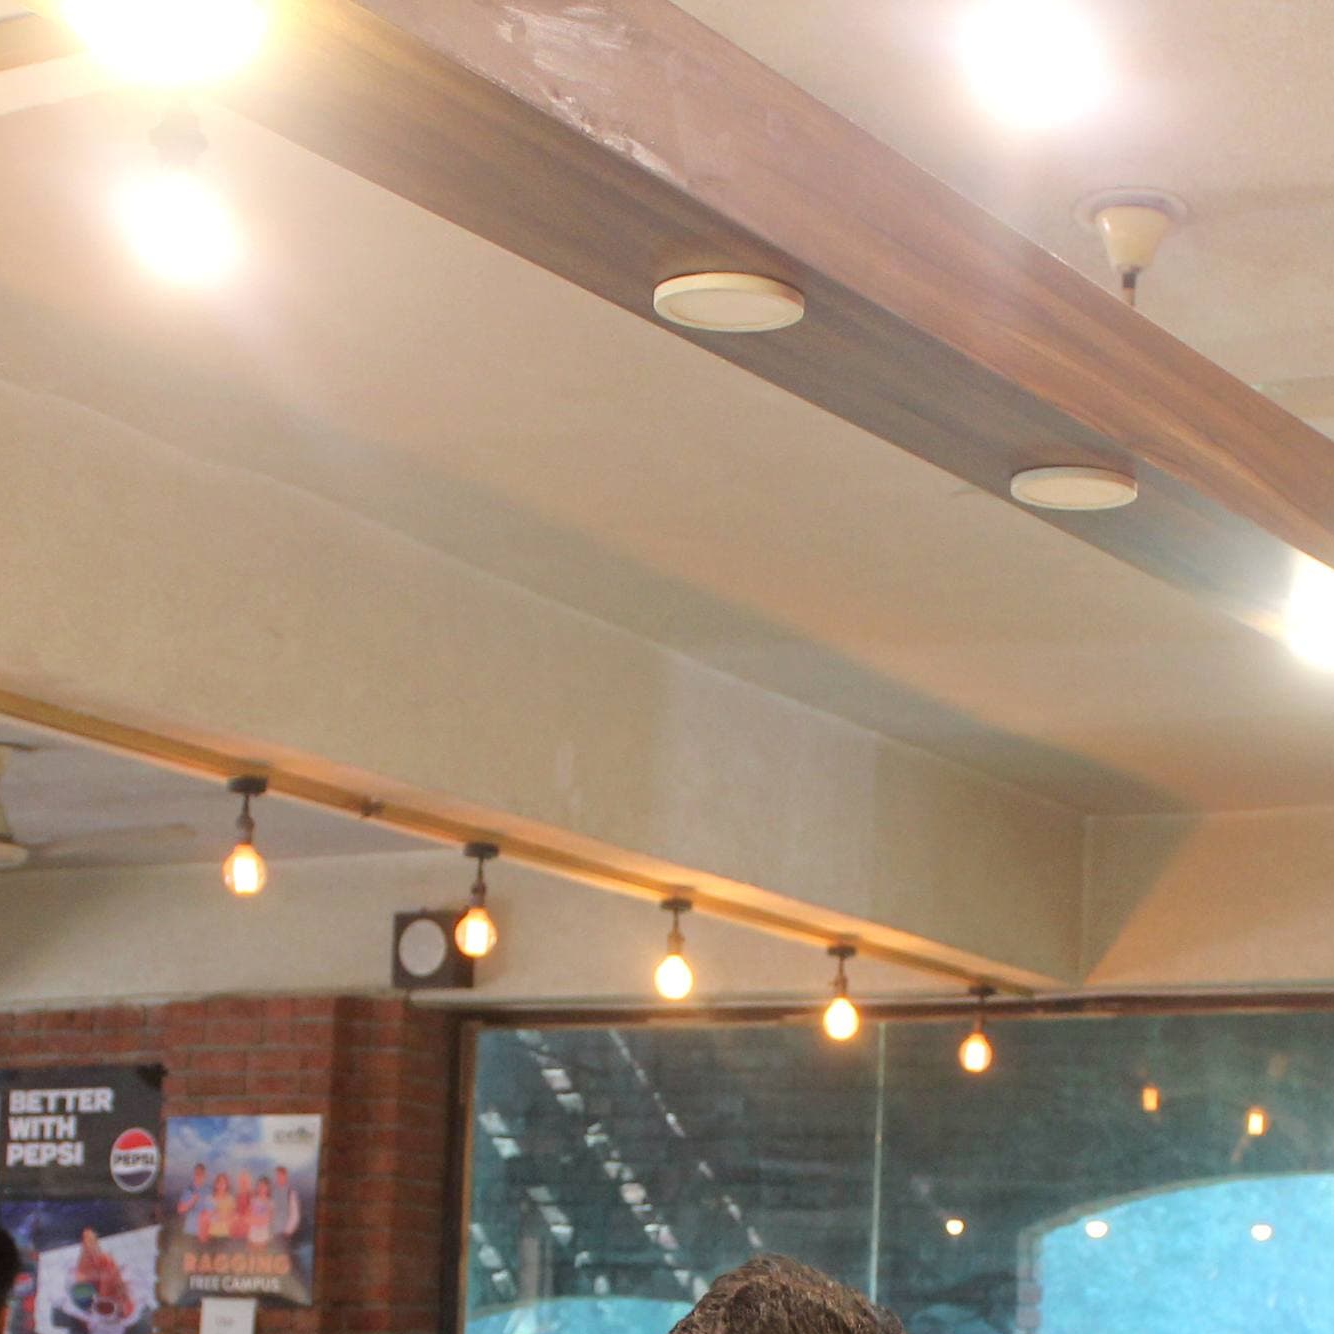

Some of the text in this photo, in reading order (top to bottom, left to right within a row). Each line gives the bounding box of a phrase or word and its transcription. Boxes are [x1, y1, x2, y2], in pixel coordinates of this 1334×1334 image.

[9, 1087, 114, 1113] BETTER
[9, 1115, 77, 1140] WITH
[6, 1142, 85, 1167] PEPSI
[113, 1152, 156, 1167] PEPSI
[183, 1252, 291, 1275] RAGGING
[189, 1275, 281, 1293] FREE CAMPUS
